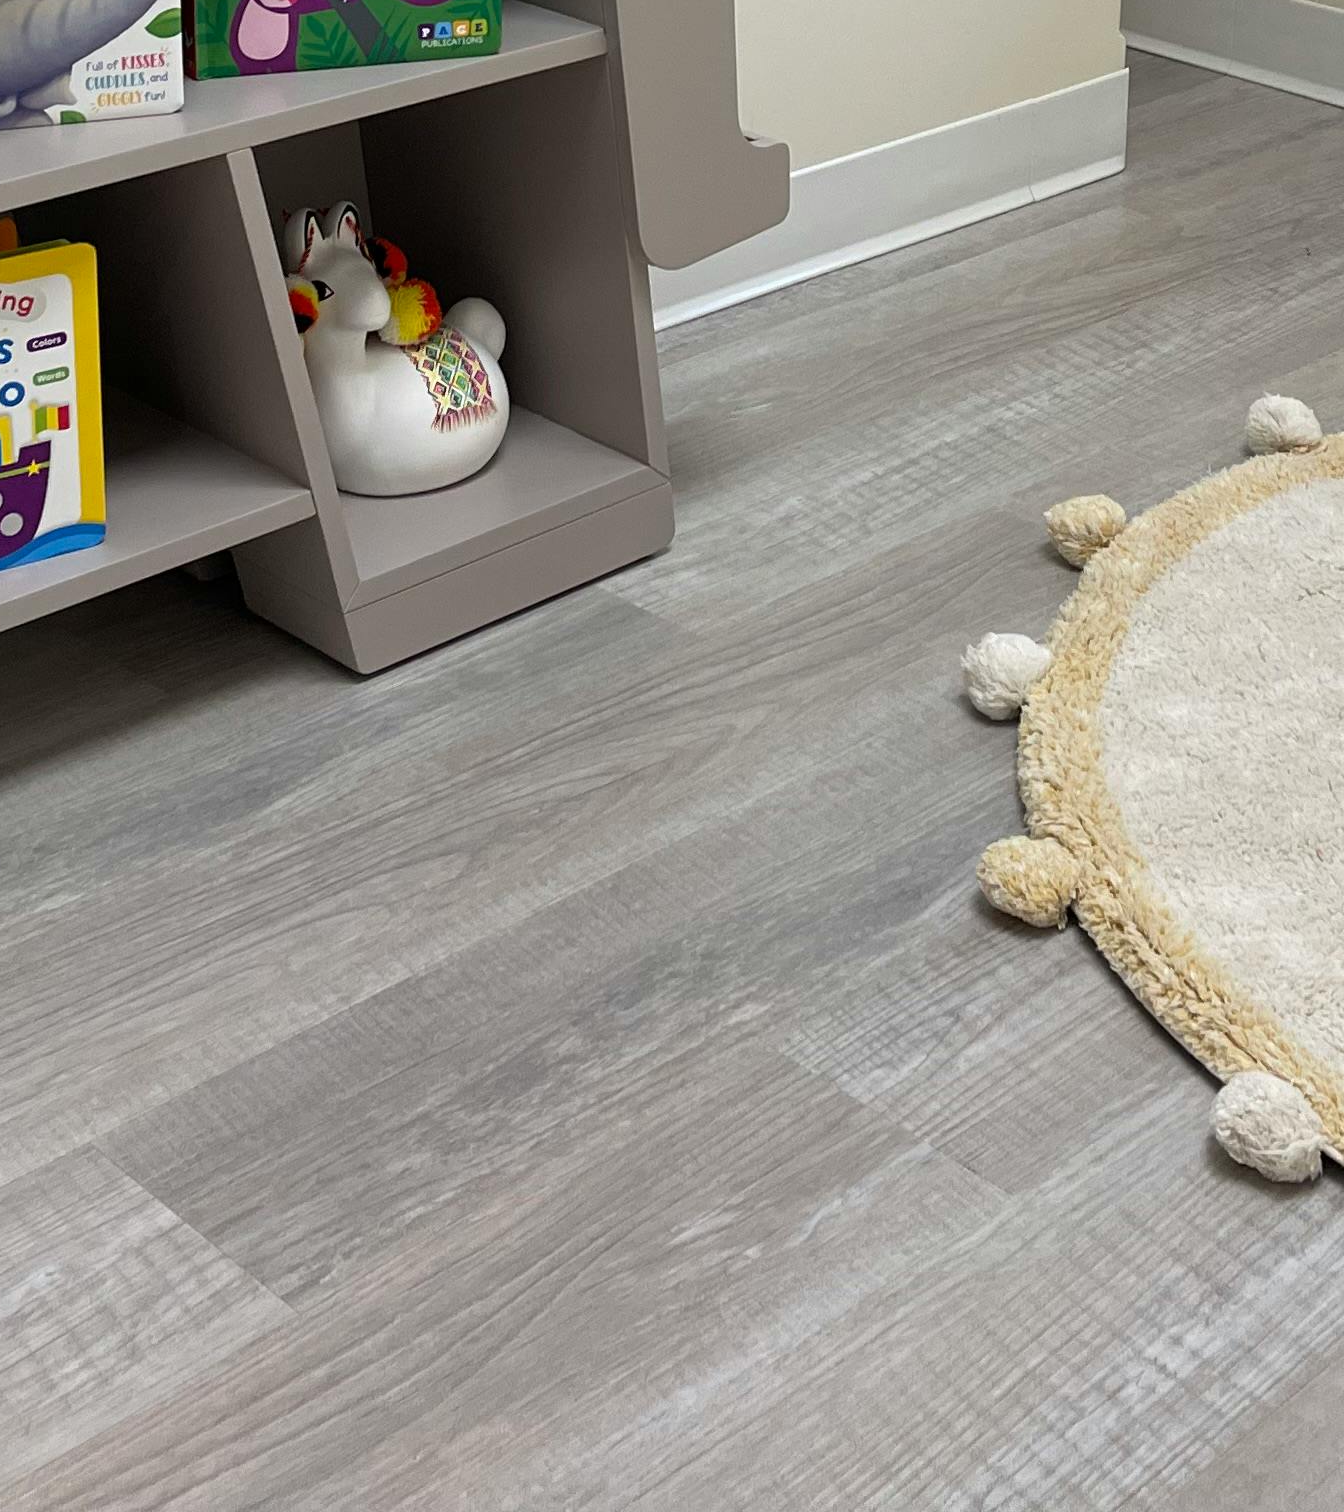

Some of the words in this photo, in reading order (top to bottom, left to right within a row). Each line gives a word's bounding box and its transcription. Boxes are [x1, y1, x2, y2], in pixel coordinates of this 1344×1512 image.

[421, 36, 484, 48] PUBLICATIONS
[107, 60, 119, 70] of
[150, 71, 168, 82] and
[97, 90, 142, 107] GIGGLY
[144, 90, 166, 102] fun!
[32, 336, 62, 349] Colors
[36, 371, 66, 383] Words
